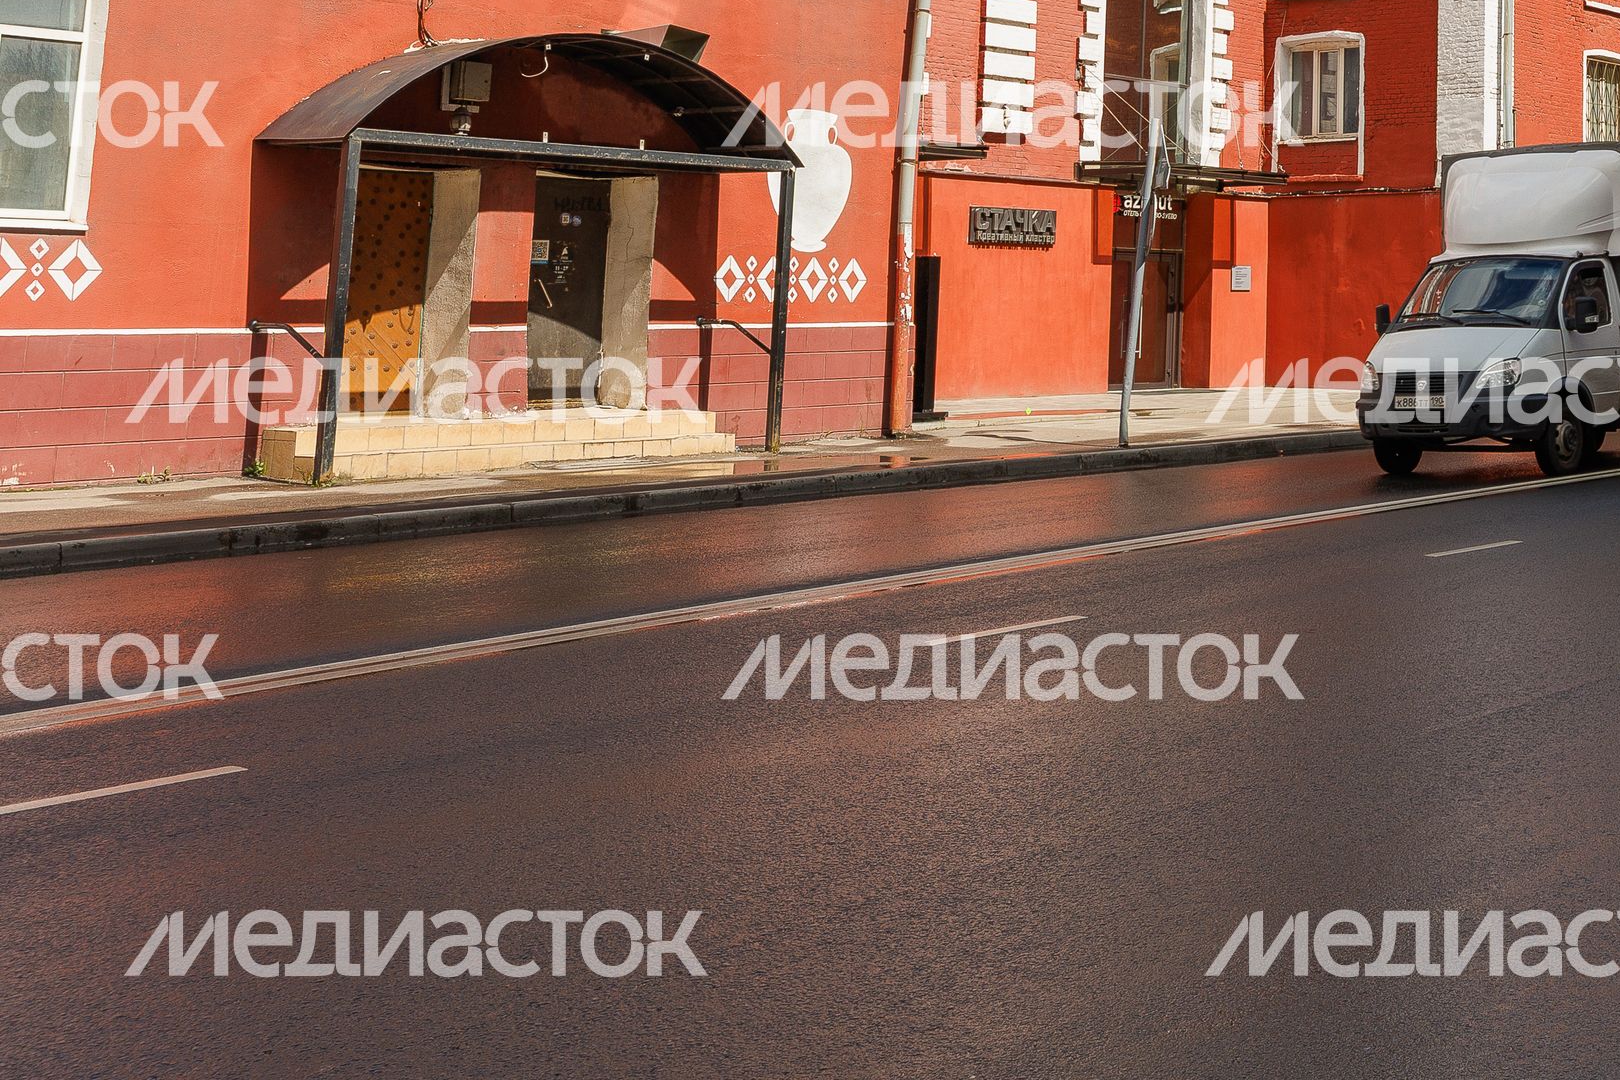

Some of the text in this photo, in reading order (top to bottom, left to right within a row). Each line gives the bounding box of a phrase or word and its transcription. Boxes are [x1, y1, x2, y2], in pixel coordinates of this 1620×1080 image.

[976, 208, 1056, 233] СТАЧКА
[977, 231, 1055, 245] Креативный кластер
